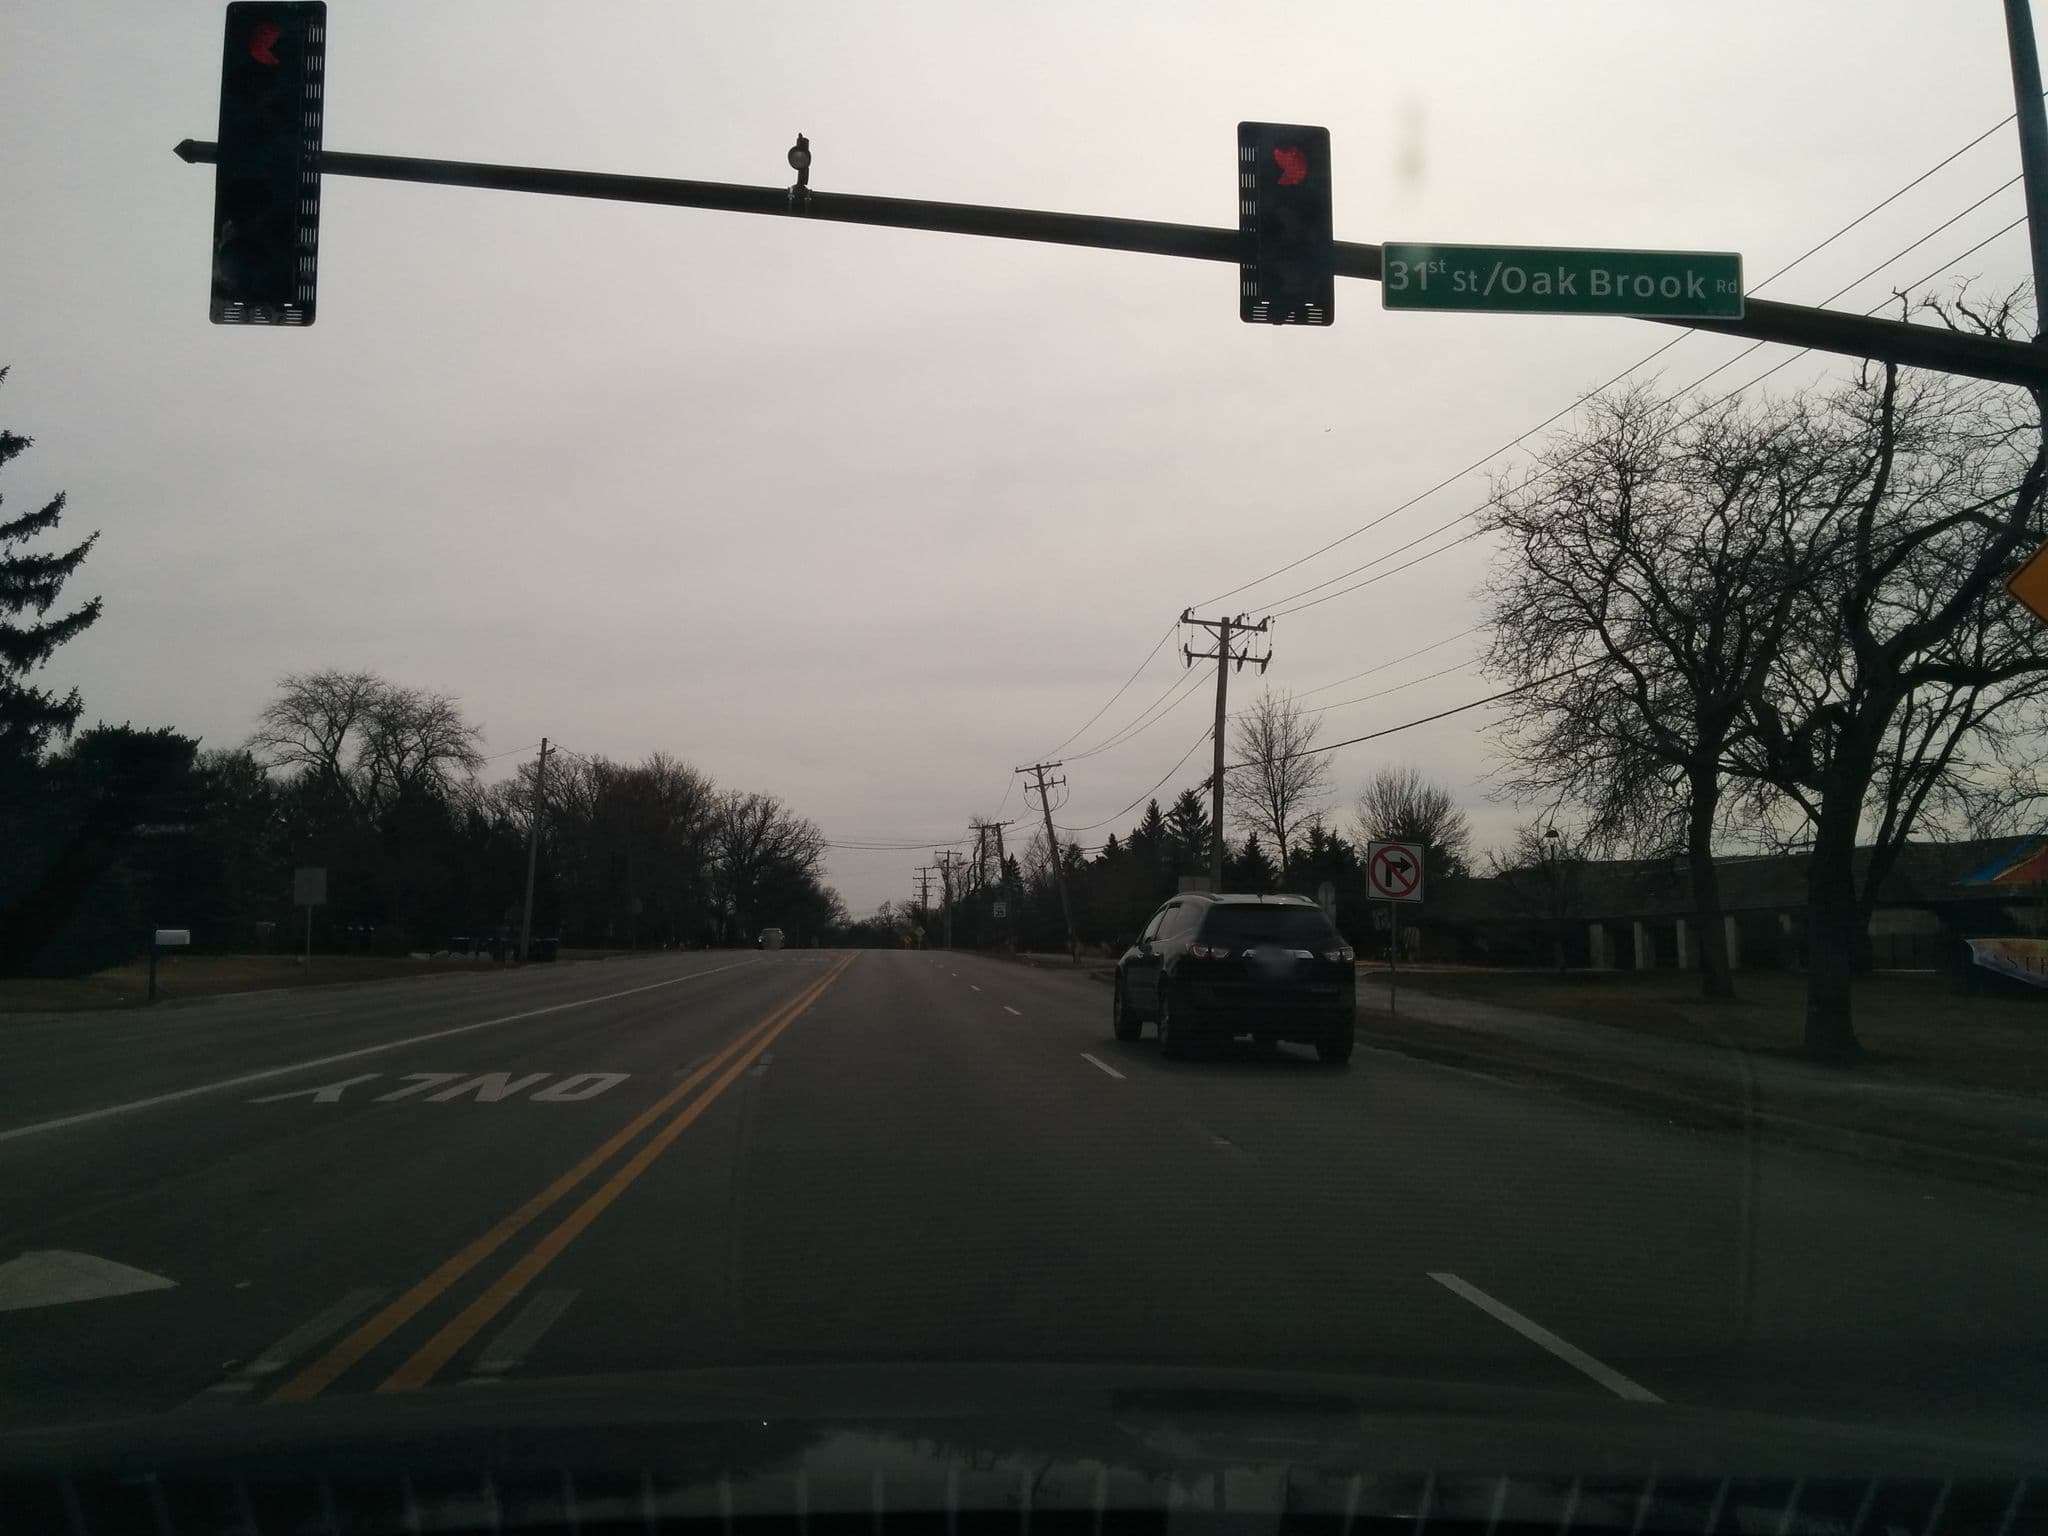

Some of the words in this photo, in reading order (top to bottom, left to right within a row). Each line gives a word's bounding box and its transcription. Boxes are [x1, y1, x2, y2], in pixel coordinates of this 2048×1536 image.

[1389, 260, 1446, 291] 31st
[1590, 269, 1706, 299] Brook
[1716, 279, 1737, 294] Rd
[247, 1073, 631, 1102] ONLY
